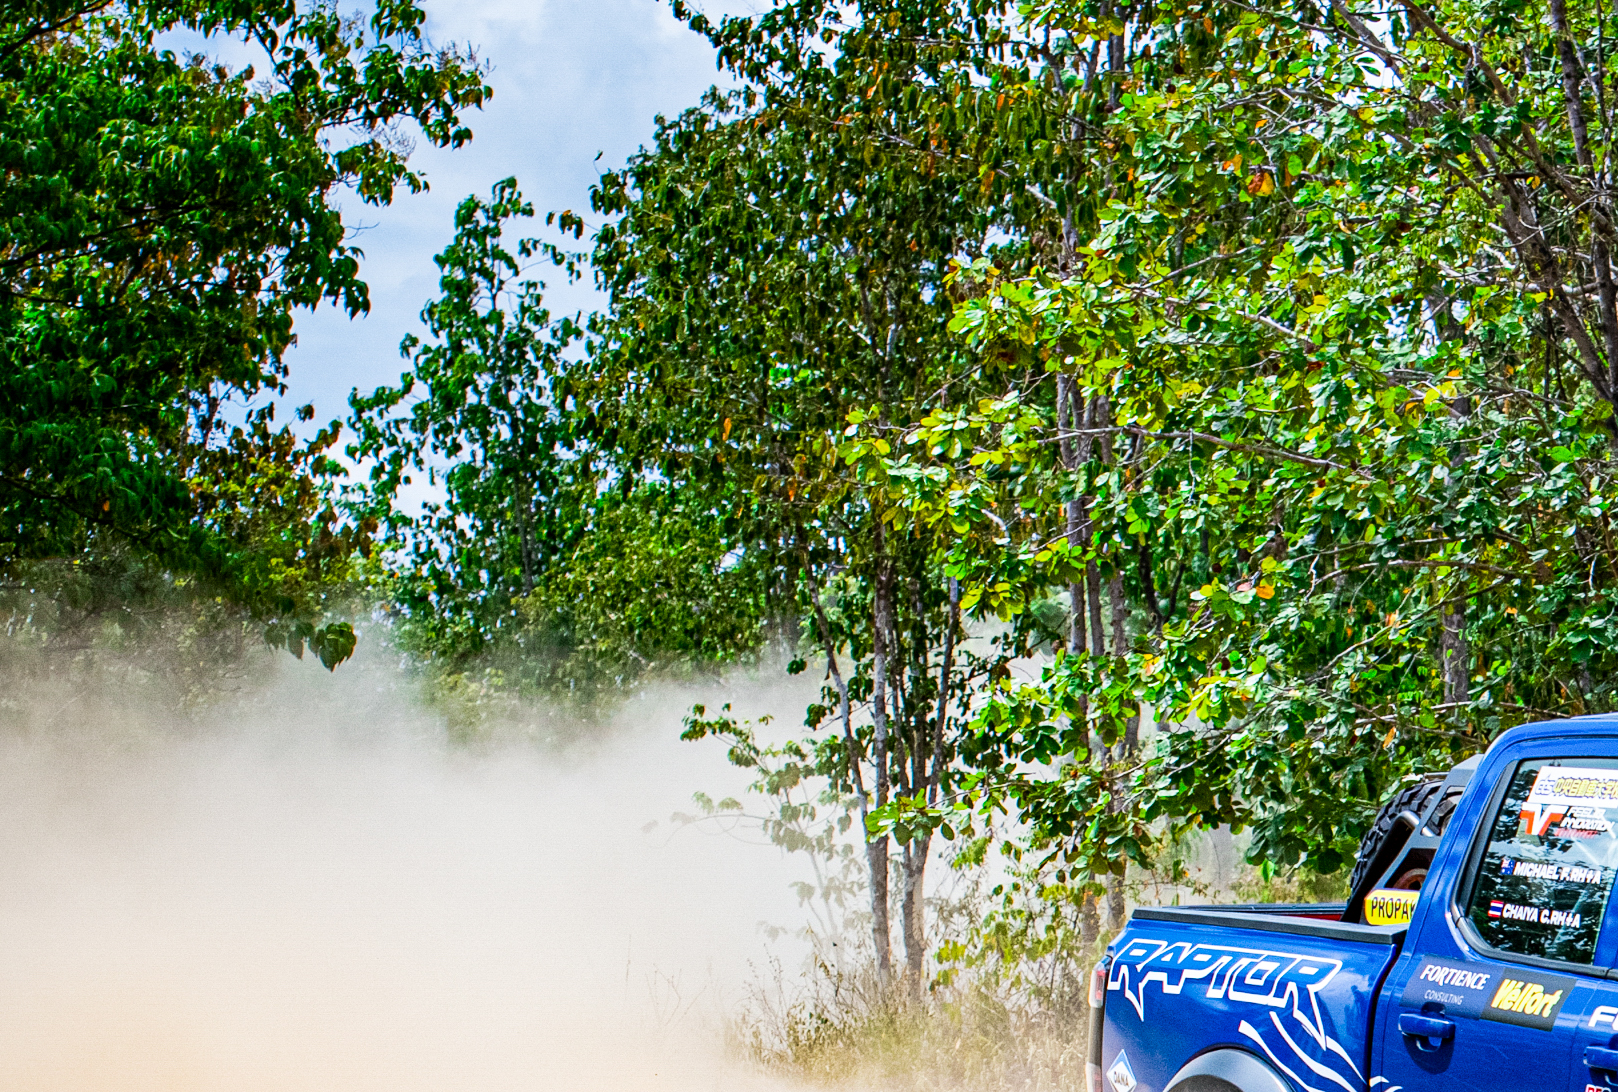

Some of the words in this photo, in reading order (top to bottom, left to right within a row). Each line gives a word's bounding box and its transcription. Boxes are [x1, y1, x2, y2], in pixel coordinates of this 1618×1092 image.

[1513, 861, 1559, 881] MICHAEL
[1502, 903, 1539, 922] CHAIYA
[1420, 964, 1491, 990] FORTIENCE
[1107, 938, 1344, 1051] RAPTOR
[1424, 989, 1464, 1006] CONSULTING
